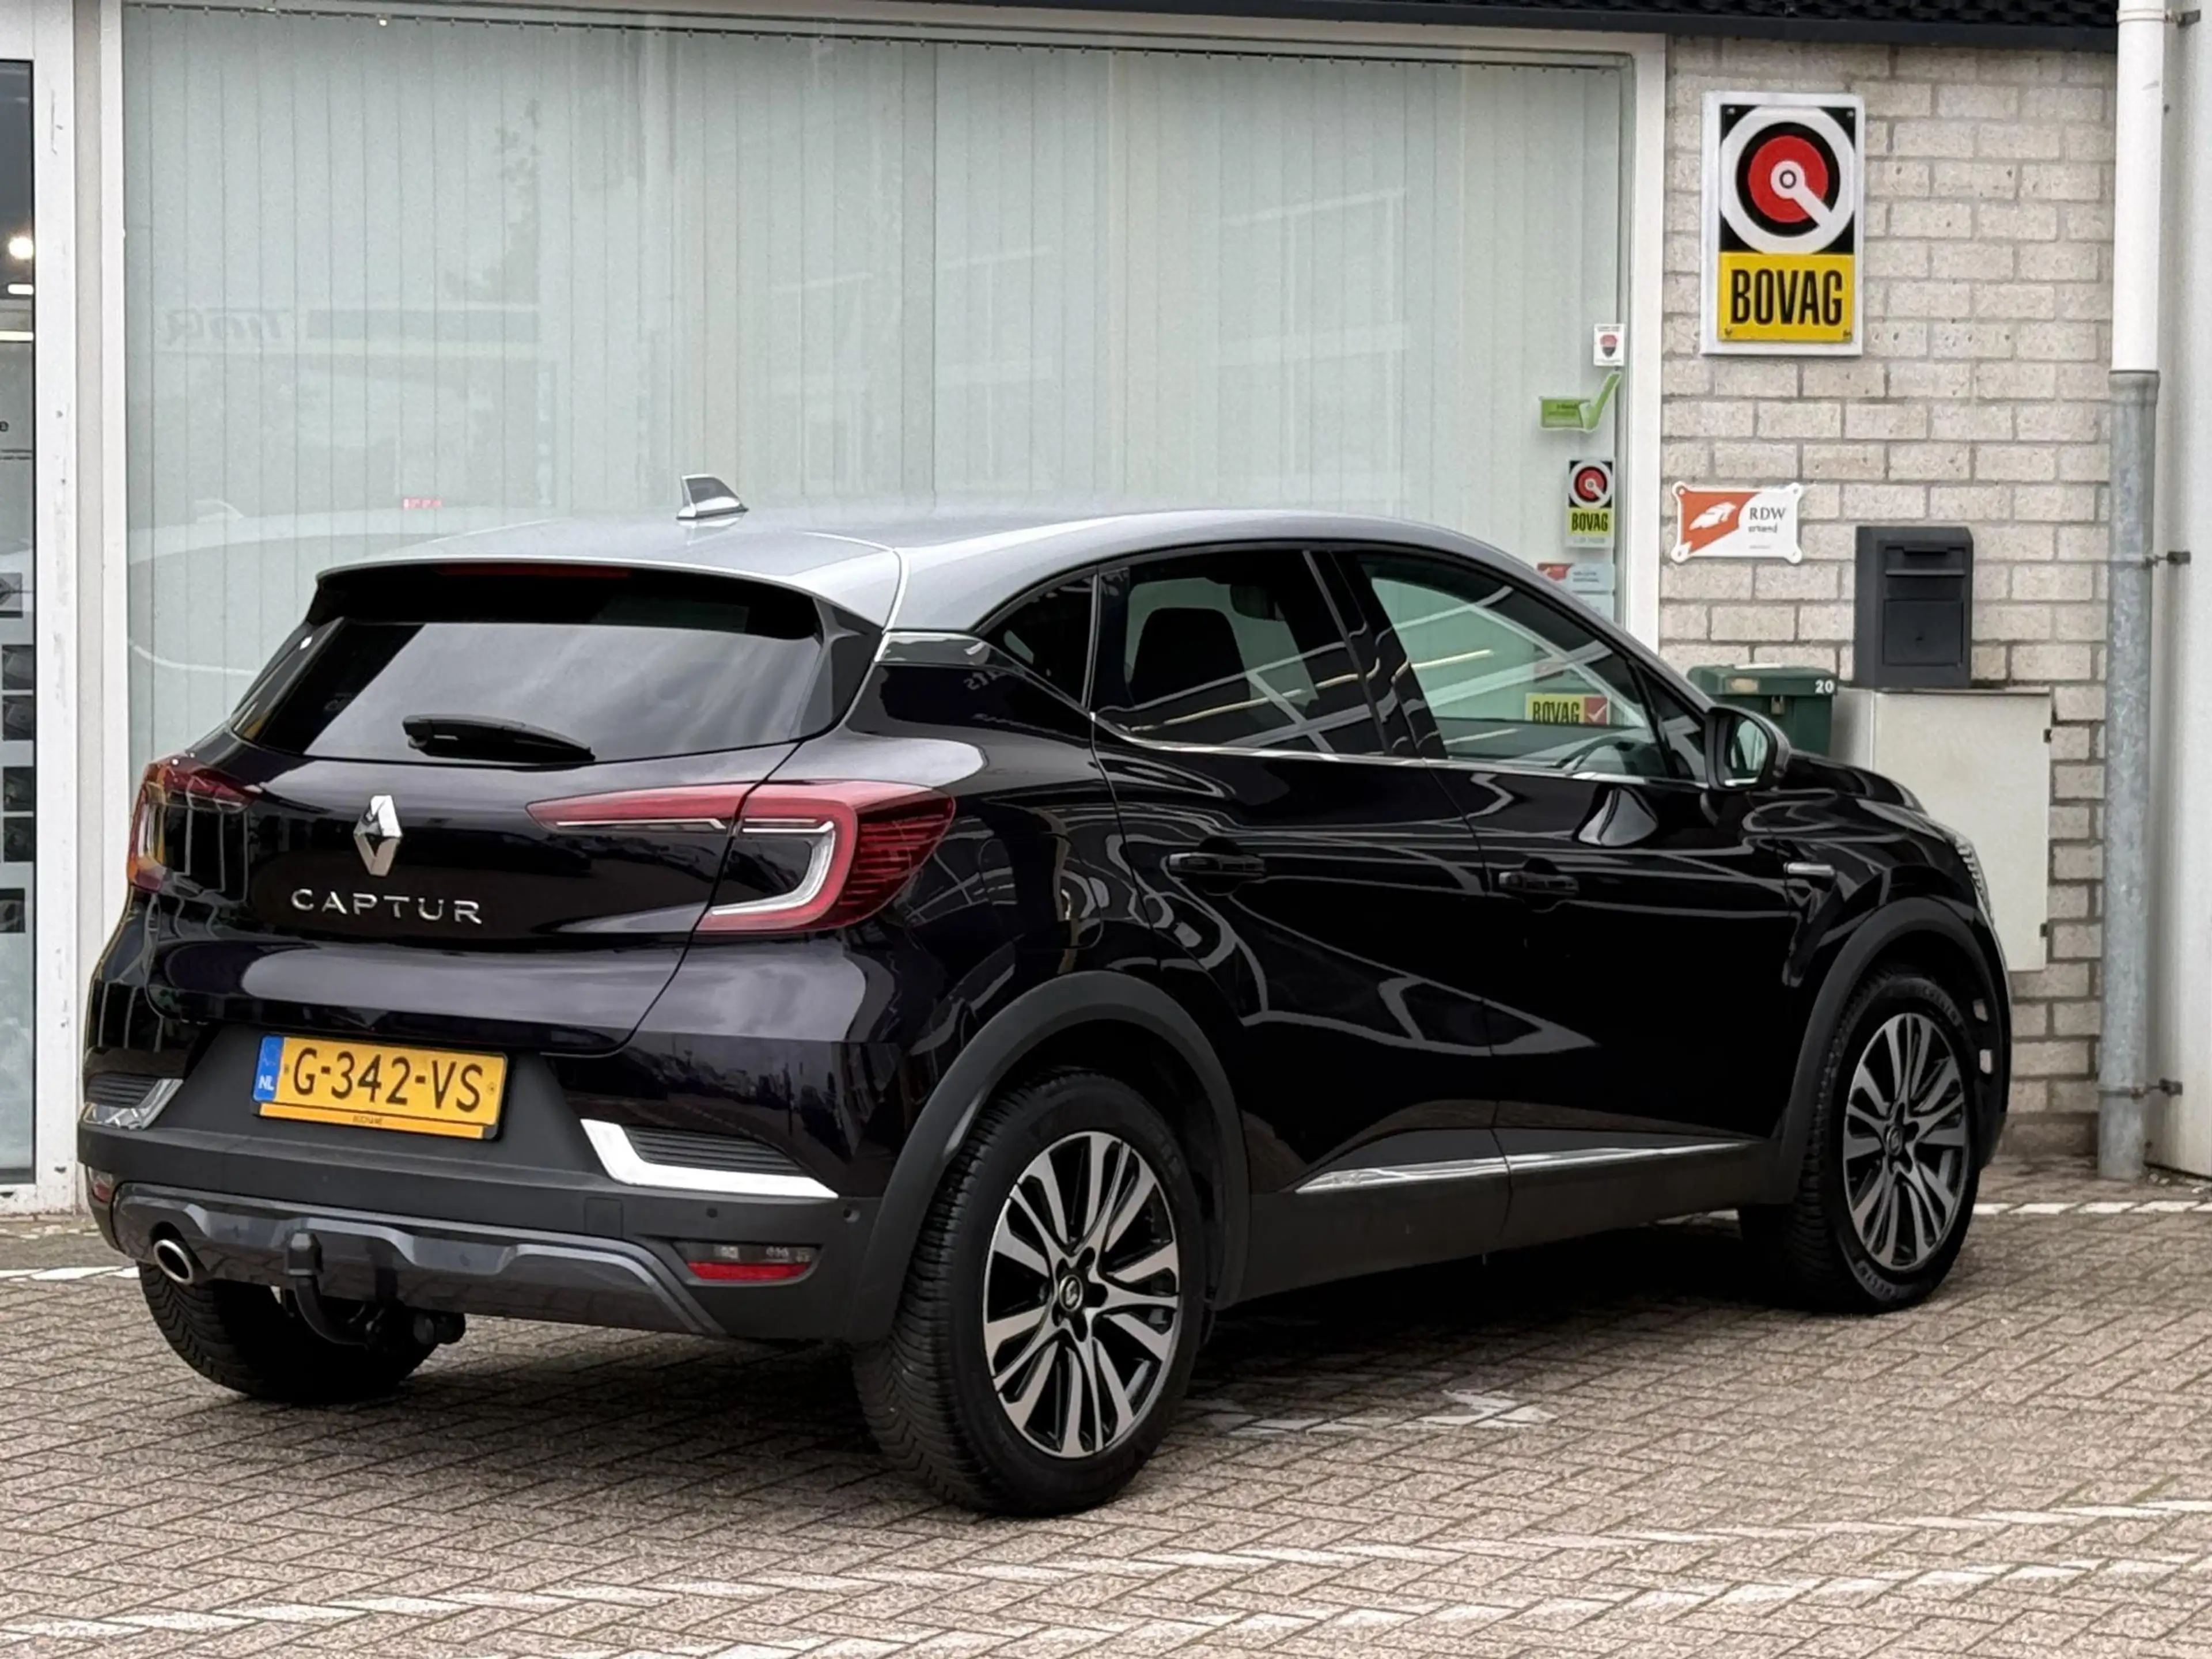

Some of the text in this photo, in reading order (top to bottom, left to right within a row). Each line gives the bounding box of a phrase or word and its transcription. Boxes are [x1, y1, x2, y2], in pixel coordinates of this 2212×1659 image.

[1730, 268, 1843, 326] BOVAG
[1571, 512, 1608, 531] BOVAG
[1749, 507, 1786, 520] RDW
[1815, 679, 1835, 694] 20
[1532, 701, 1580, 724] BOVAG
[291, 888, 482, 925] CAPTUR
[258, 1075, 275, 1091] NL
[293, 1047, 484, 1113] G-342-VS
